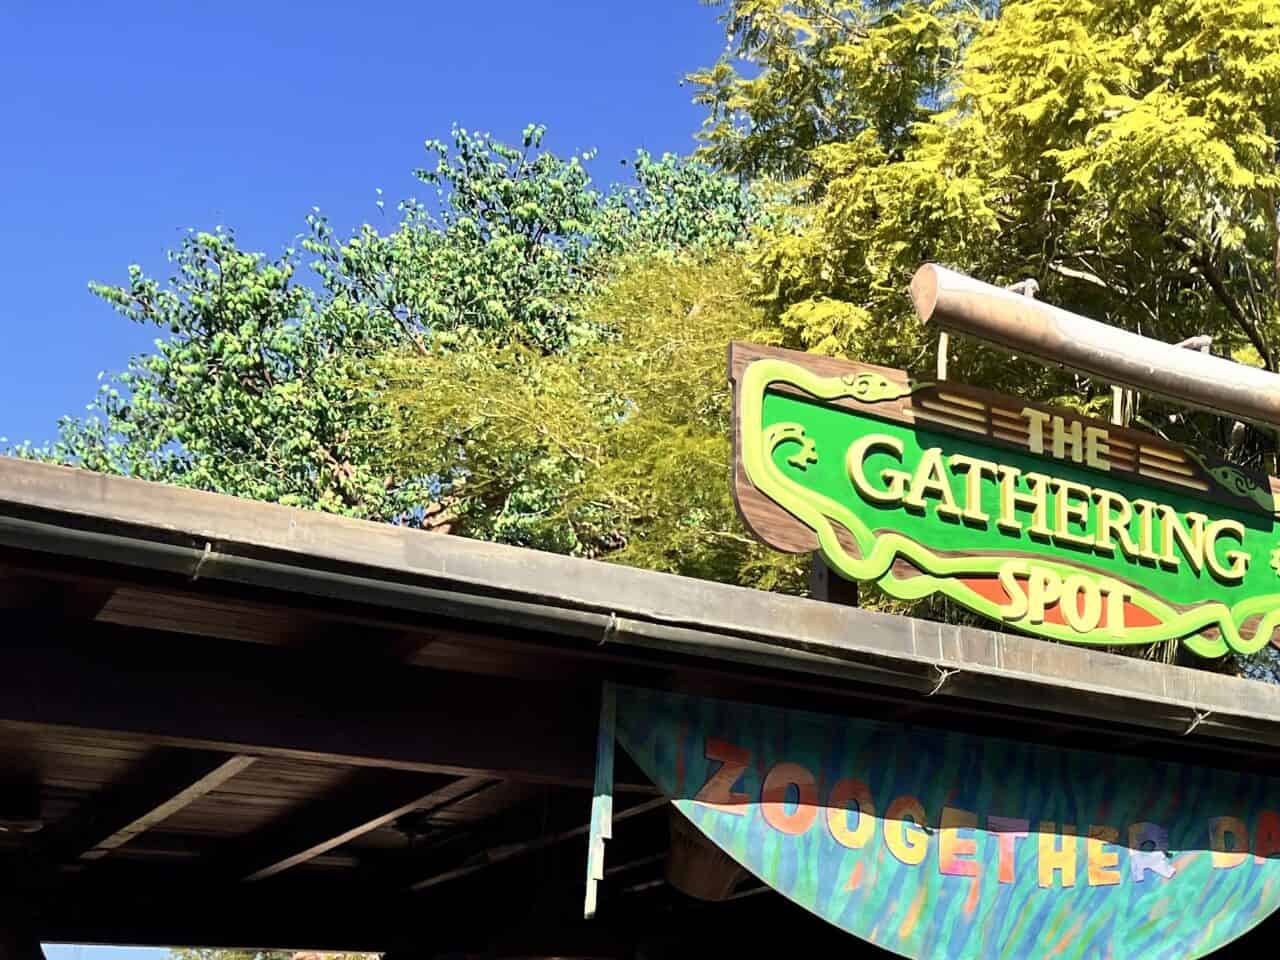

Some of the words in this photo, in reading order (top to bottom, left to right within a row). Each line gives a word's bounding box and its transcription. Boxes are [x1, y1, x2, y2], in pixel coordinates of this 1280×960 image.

[1020, 407, 1112, 471] THE
[845, 433, 1250, 581] GATHERING
[997, 558, 1134, 638] SPOT
[694, 739, 1176, 889] ZOOGETHER
